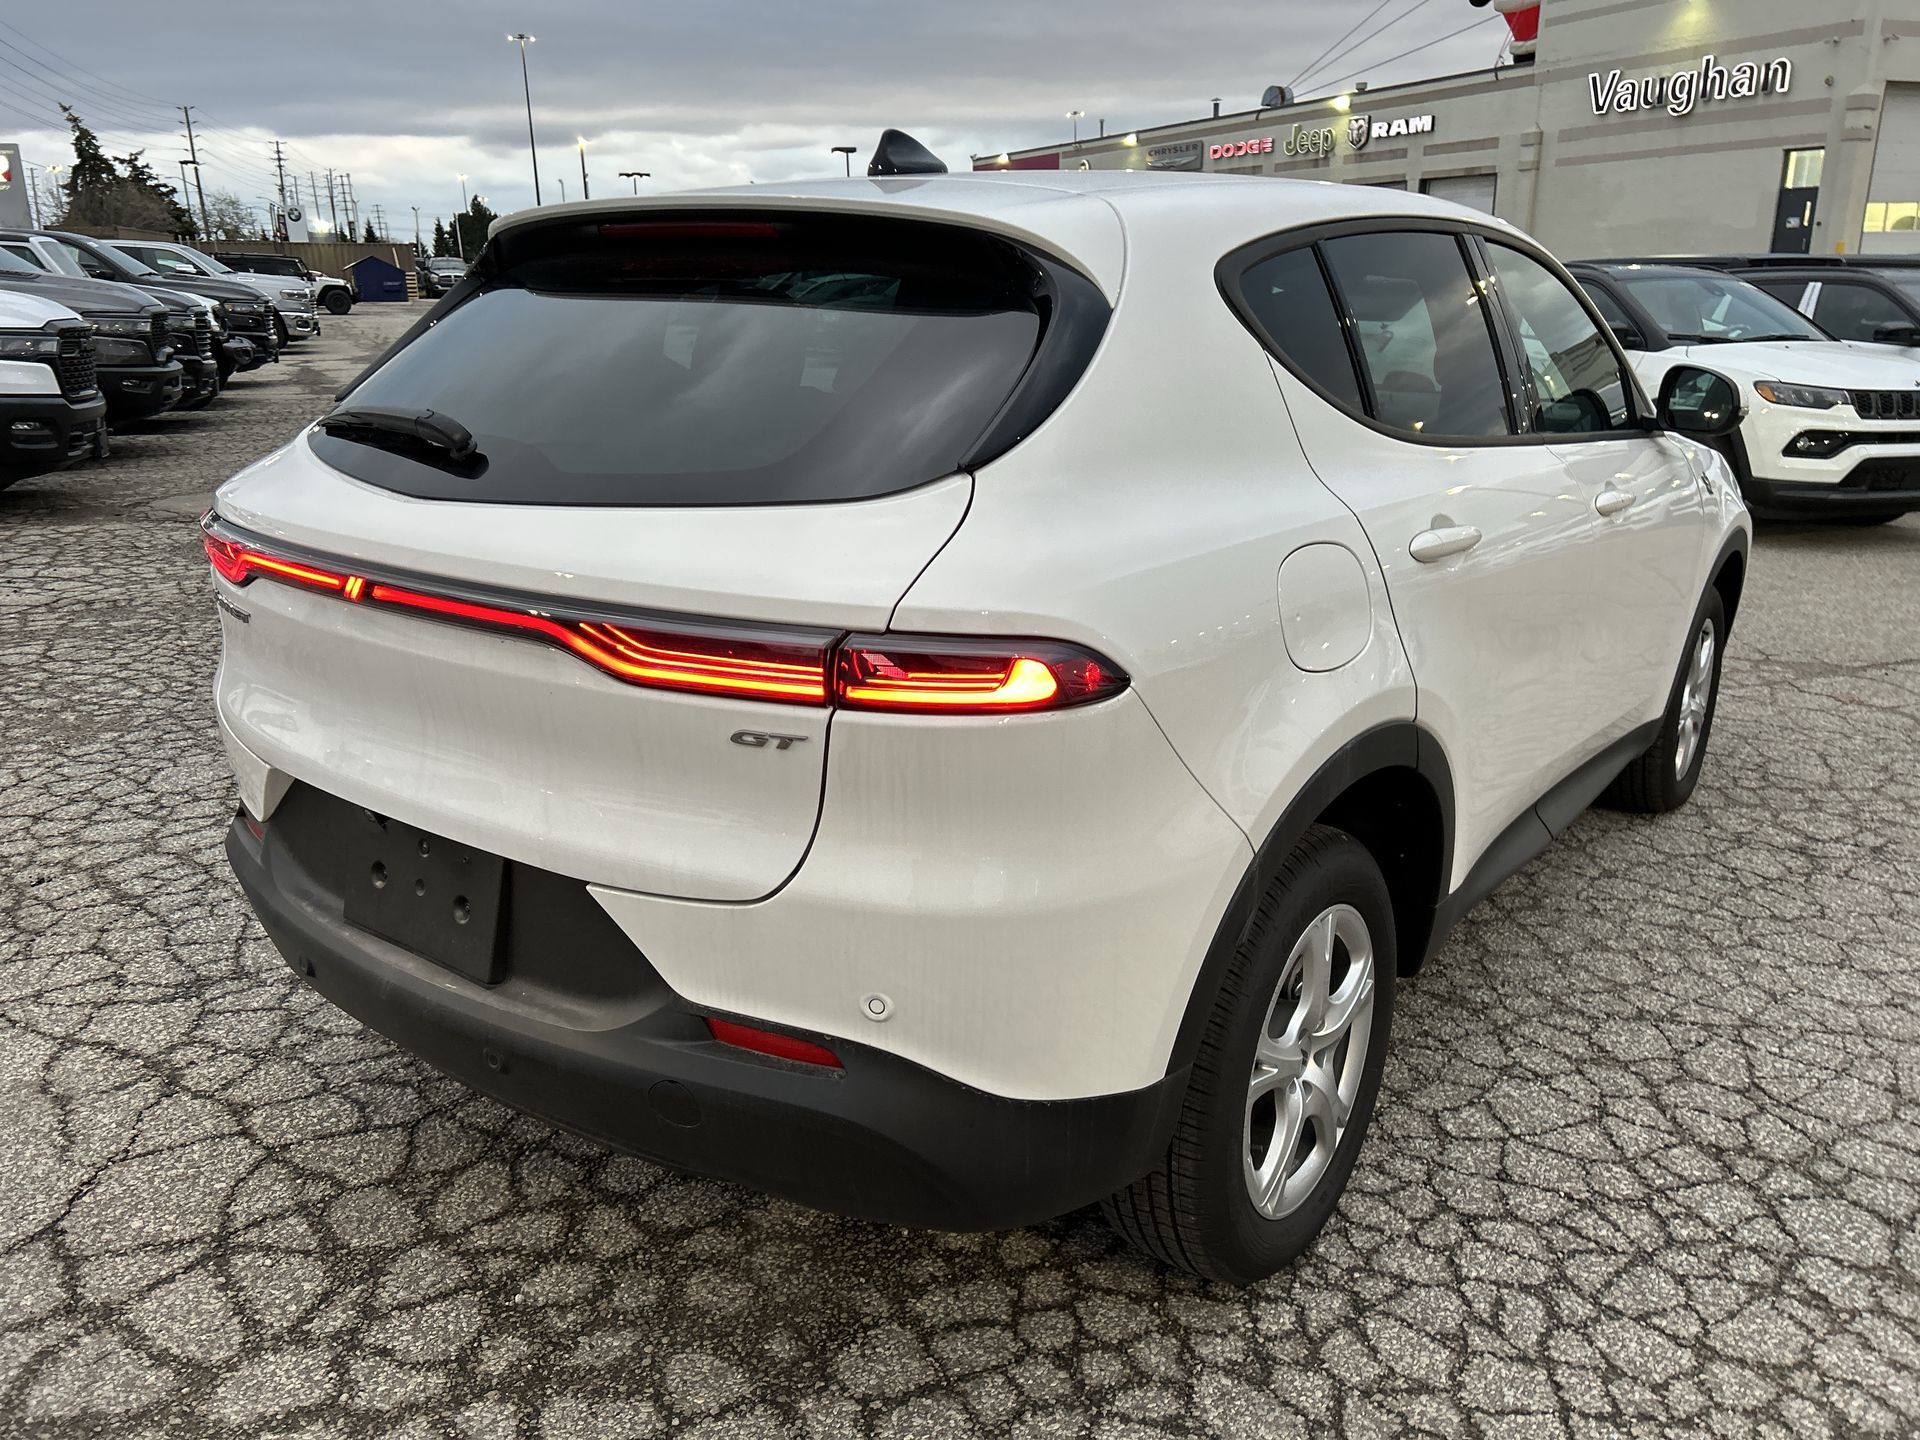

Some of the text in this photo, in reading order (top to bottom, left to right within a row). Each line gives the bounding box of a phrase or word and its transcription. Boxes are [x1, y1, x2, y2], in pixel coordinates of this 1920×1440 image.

[1588, 55, 1793, 117] Vaughan
[1371, 115, 1434, 139] RAM
[1148, 143, 1199, 157] CHRYSLER
[1209, 137, 1273, 160] DODGE
[1283, 123, 1336, 158] Jeep
[730, 729, 809, 750] GT
